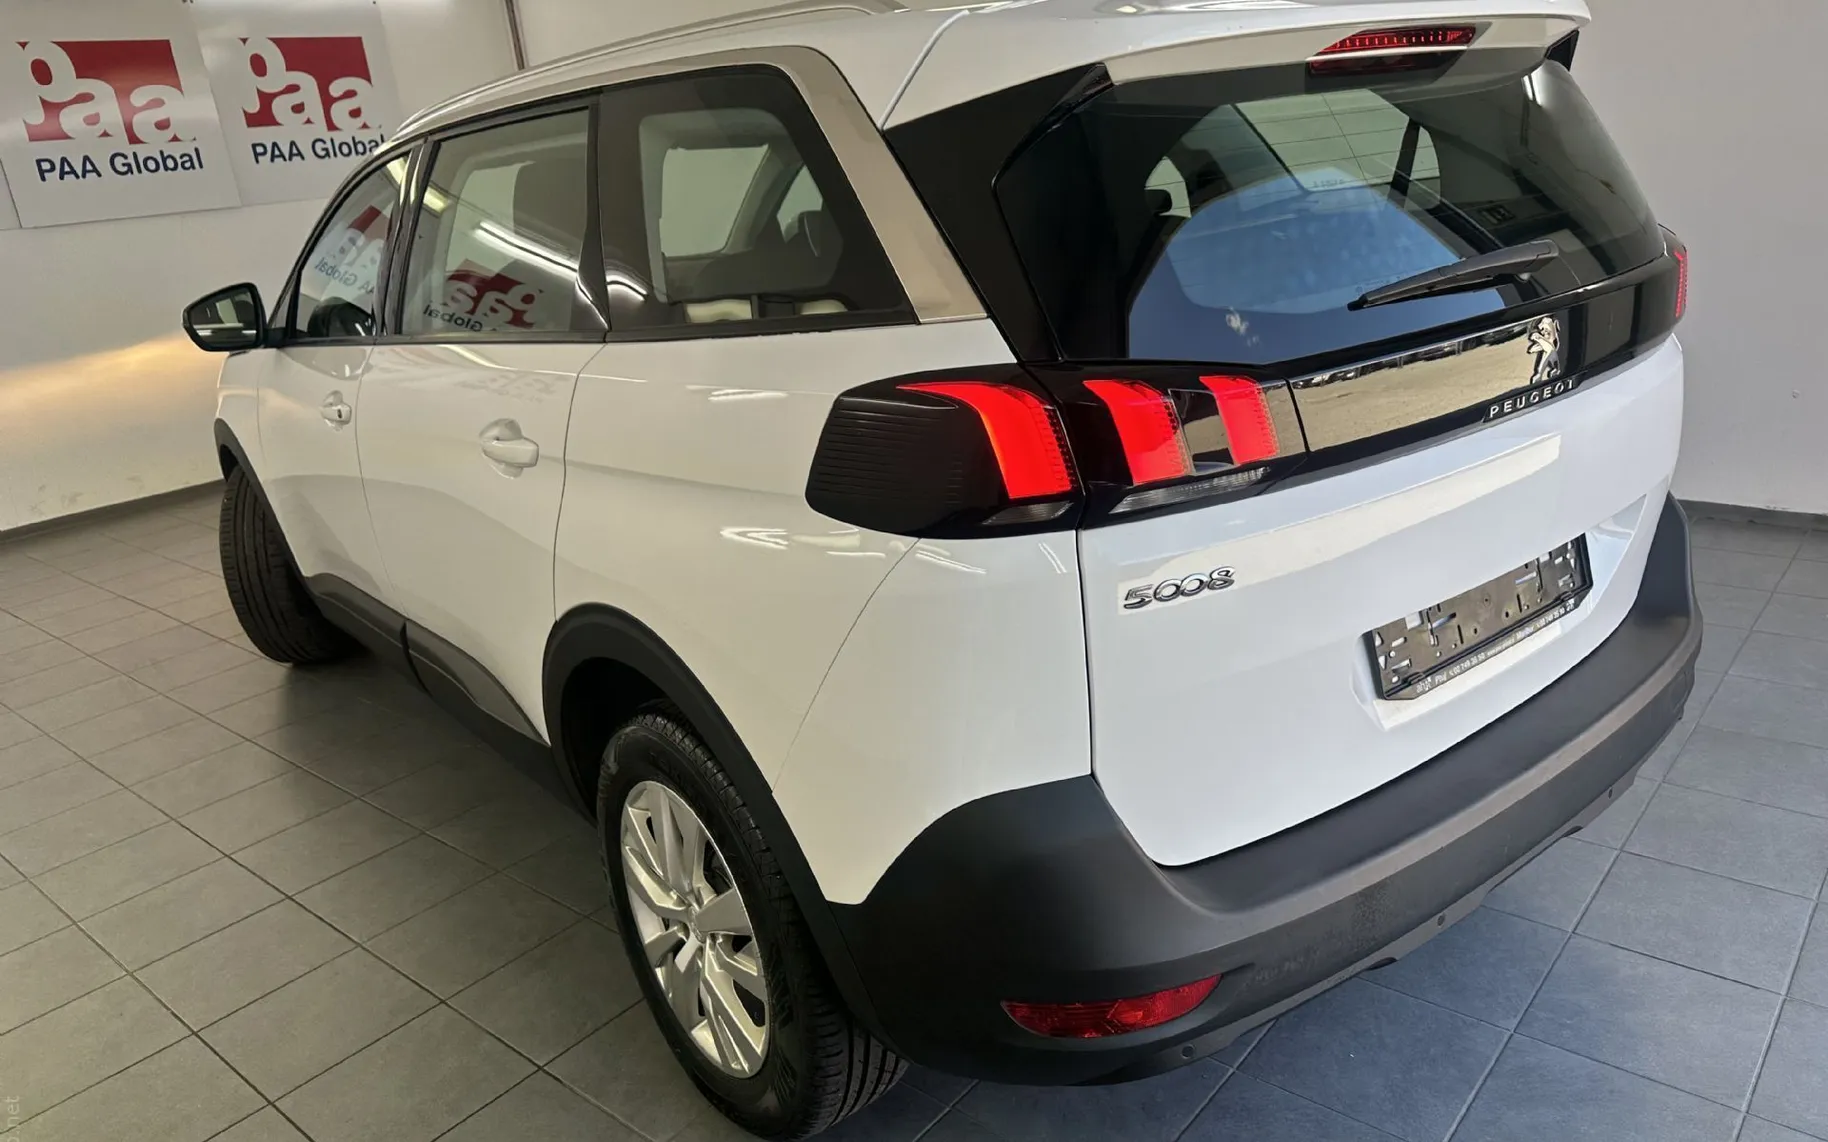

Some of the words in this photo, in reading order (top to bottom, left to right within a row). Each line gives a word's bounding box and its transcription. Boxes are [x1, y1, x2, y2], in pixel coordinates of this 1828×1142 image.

[35, 154, 103, 182] PAA
[109, 147, 204, 176] Global
[251, 140, 305, 164] PAA
[1489, 379, 1574, 418] PEUGEOT
[1123, 566, 1236, 609] 5008
